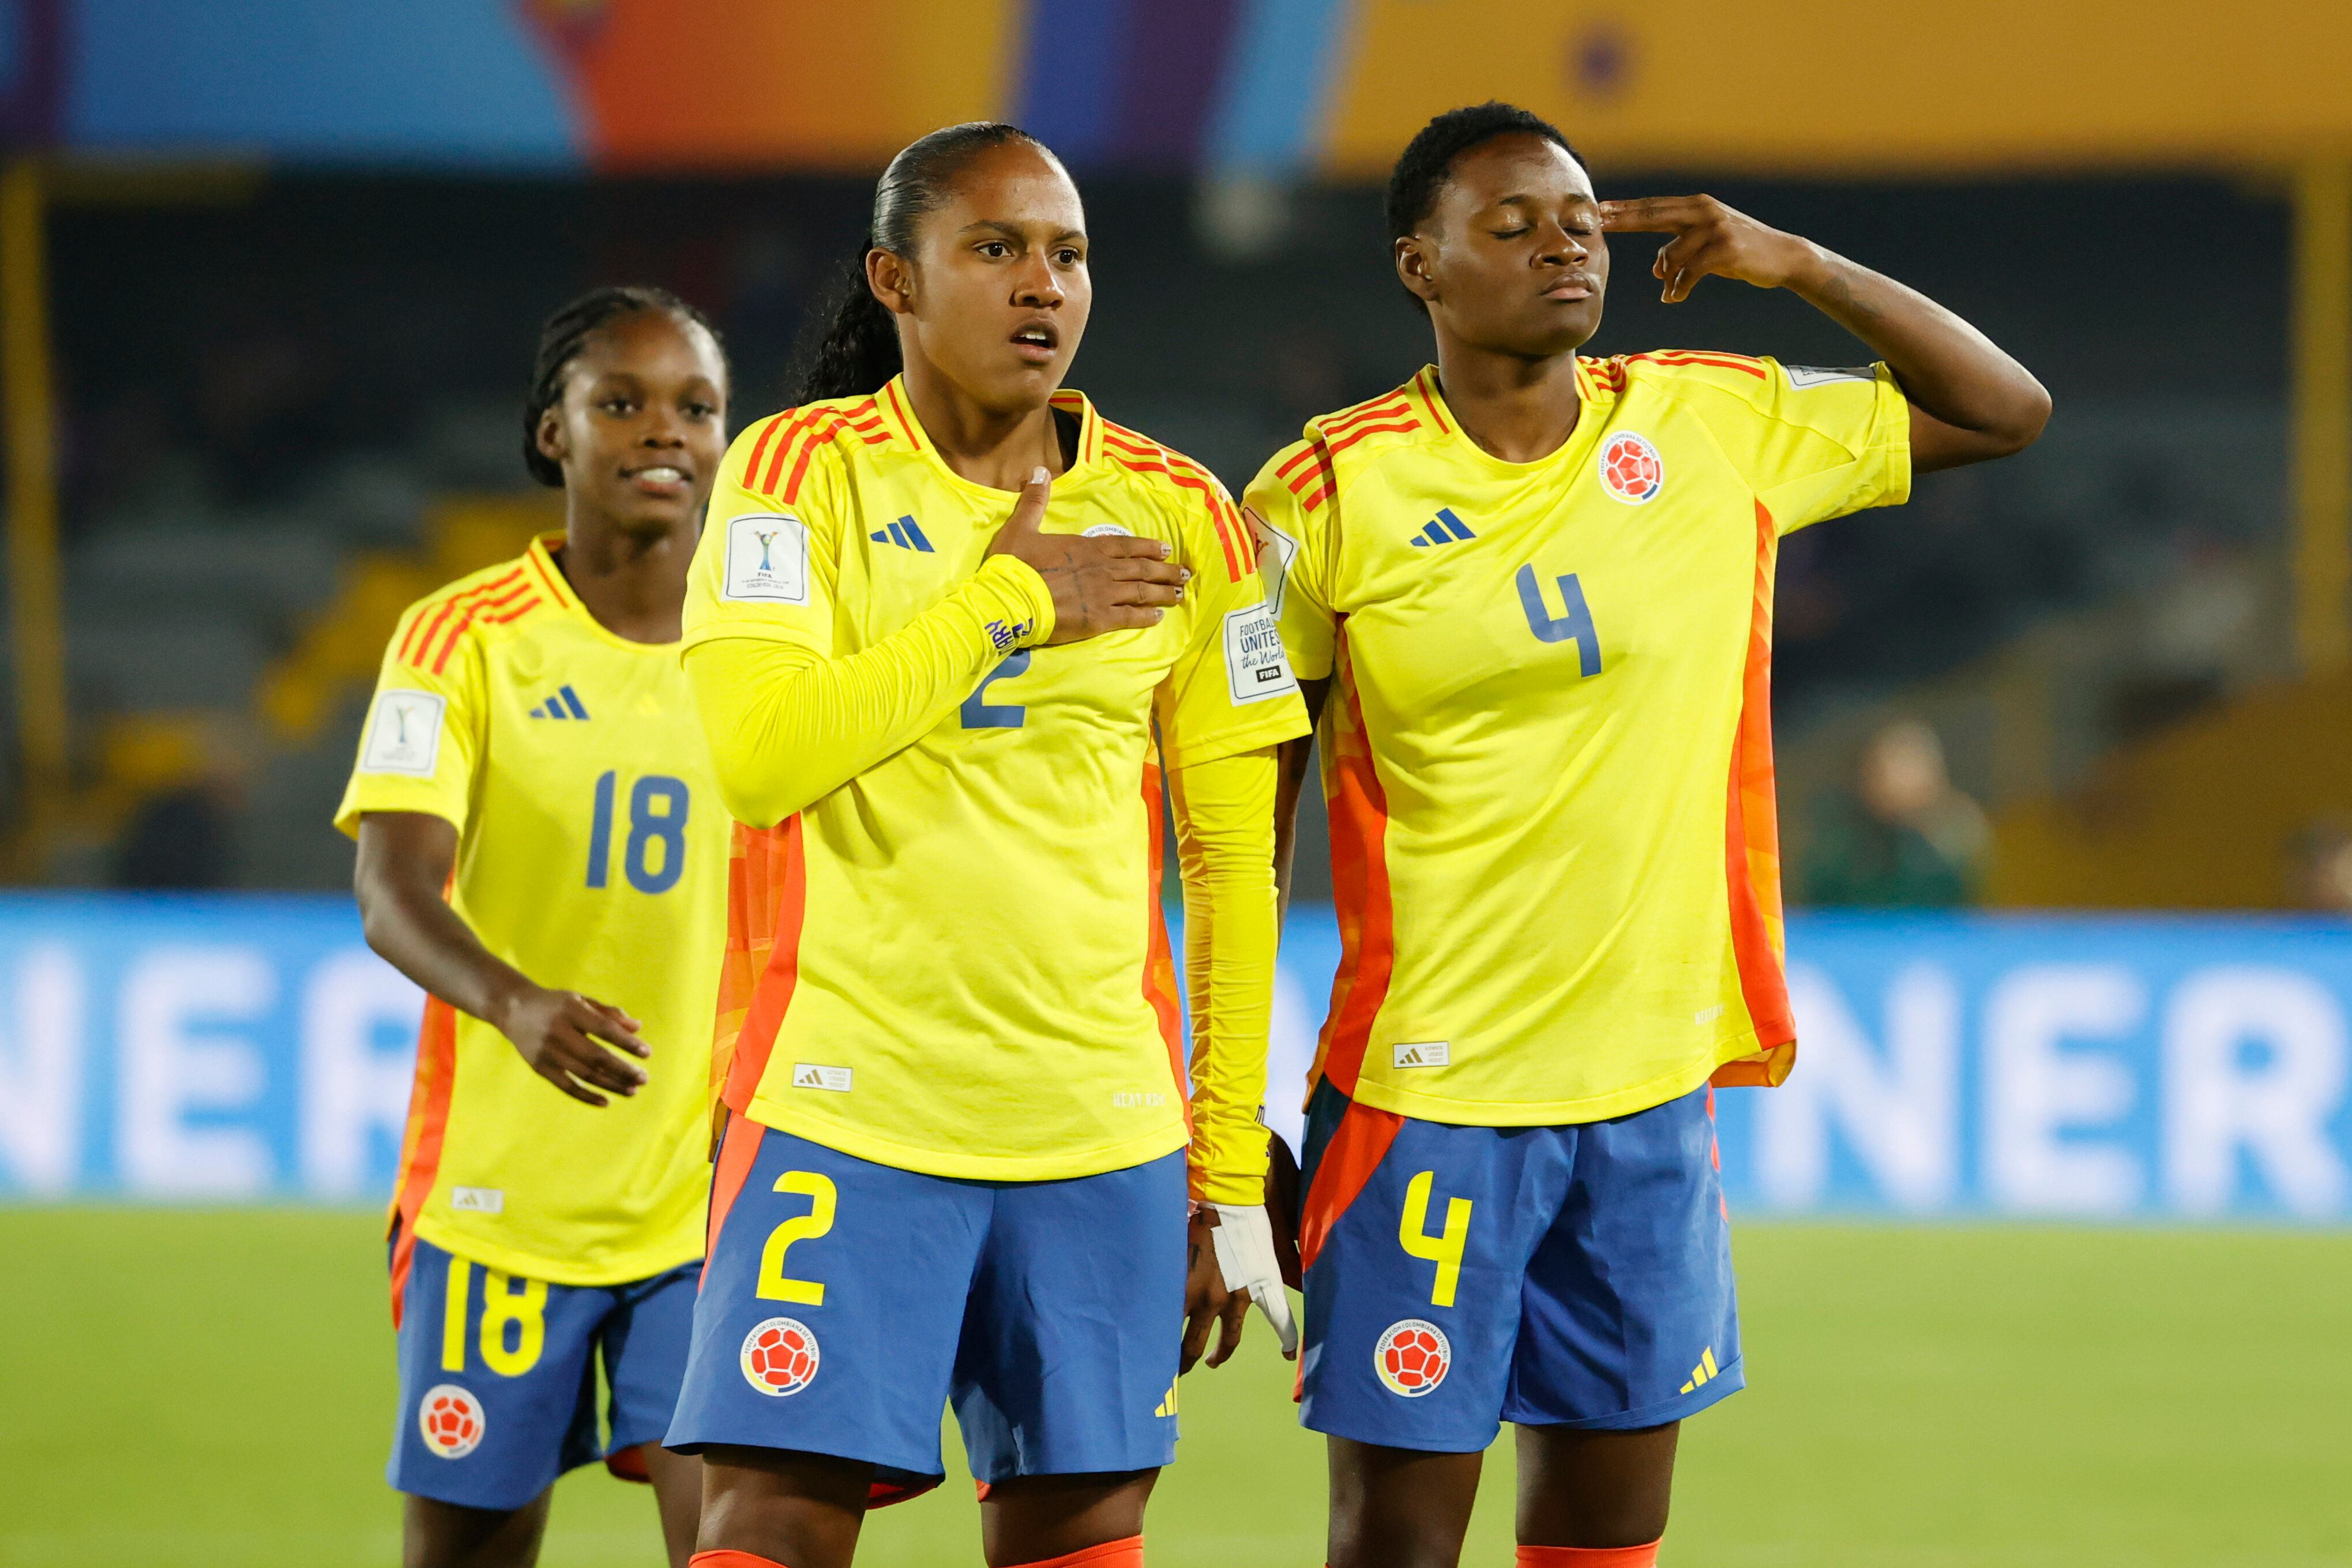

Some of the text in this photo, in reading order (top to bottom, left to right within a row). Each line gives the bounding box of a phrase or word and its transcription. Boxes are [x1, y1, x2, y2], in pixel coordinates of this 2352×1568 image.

[1240, 617, 1275, 637] FOOTBAL
[1240, 629, 1280, 653] UNITES
[1241, 654, 1258, 669] the
[1516, 563, 1602, 678] 4
[960, 647, 1031, 729] 2
[1259, 668, 1279, 680] FIFA
[585, 769, 690, 895] 18
[756, 1170, 837, 1306] 2
[1399, 1170, 1473, 1307] 4
[441, 1255, 548, 1377] 18
